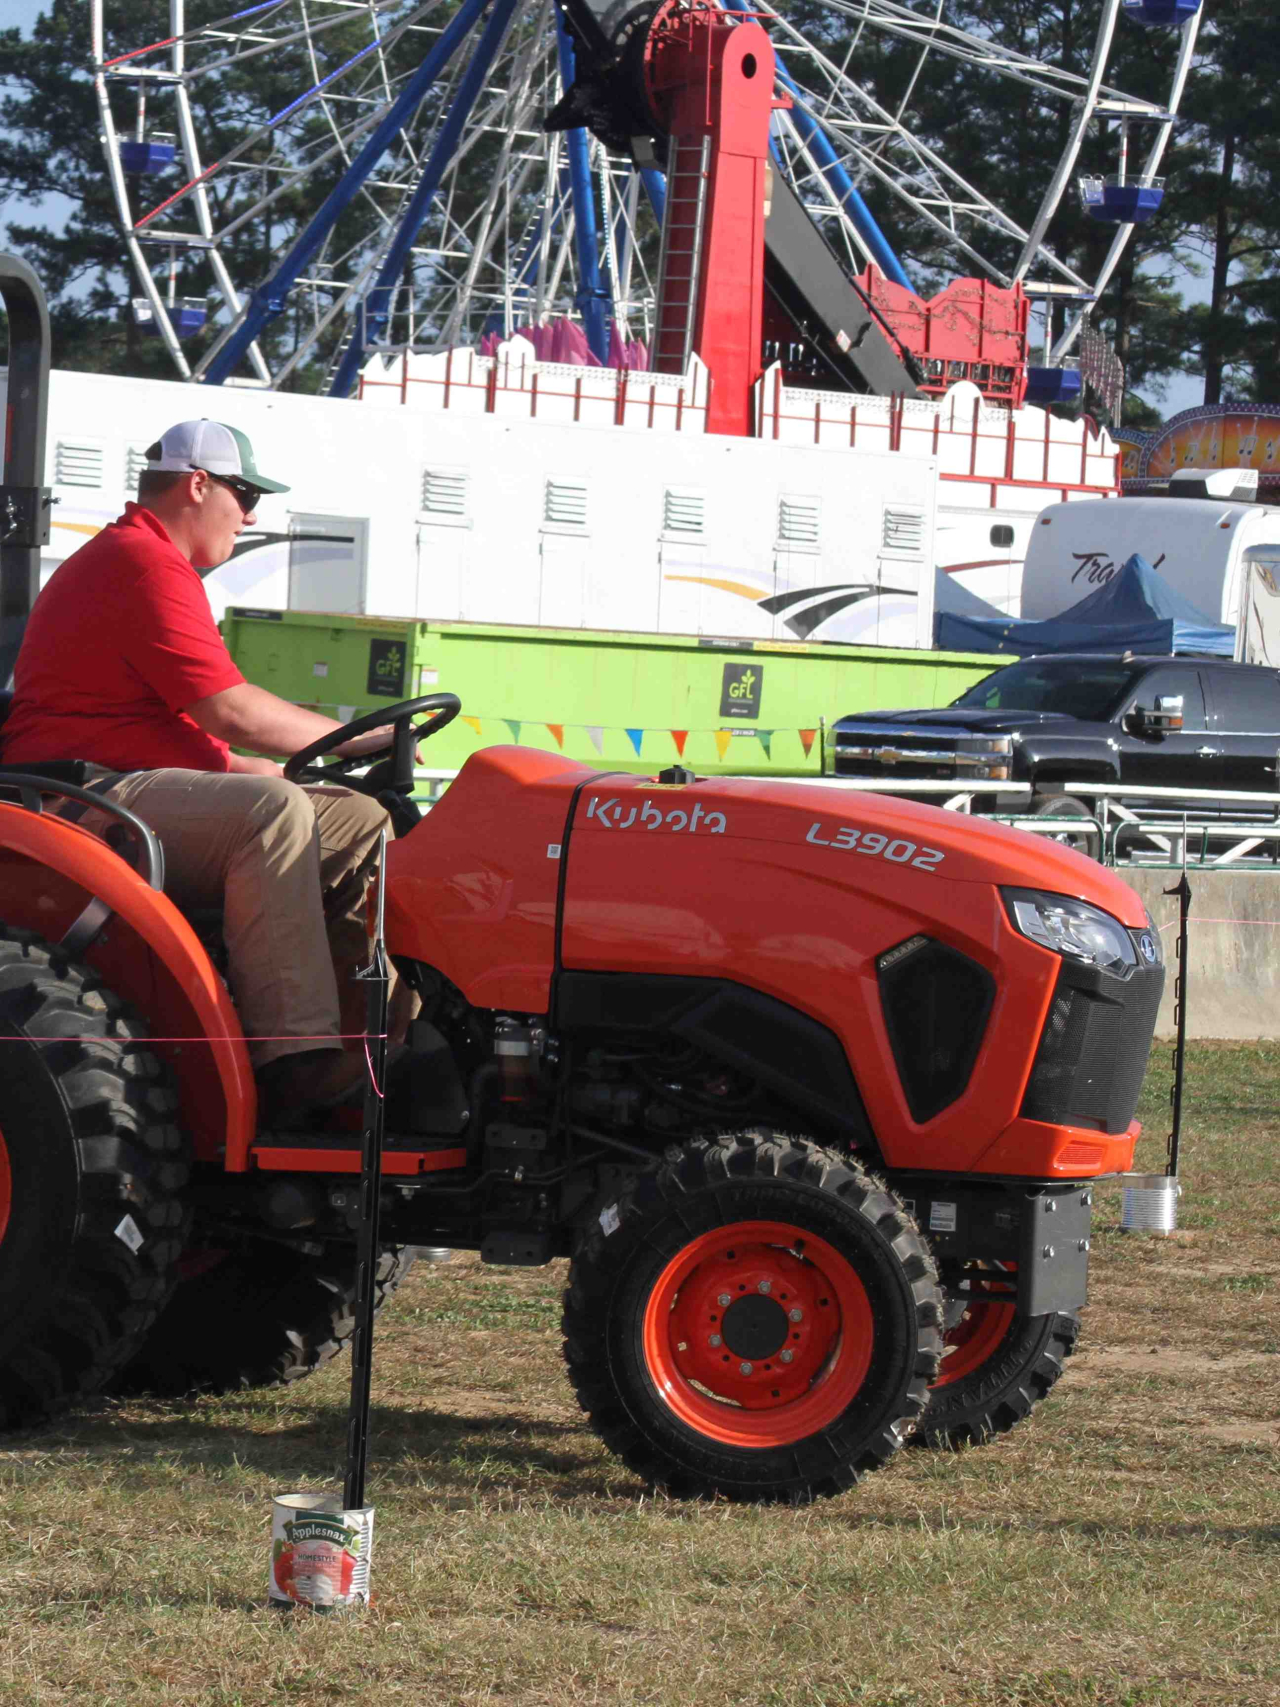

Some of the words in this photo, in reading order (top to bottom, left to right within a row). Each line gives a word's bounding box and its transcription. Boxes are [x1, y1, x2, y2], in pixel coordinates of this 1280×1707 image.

[729, 680, 753, 699] GFL
[586, 796, 727, 833] Kubota
[805, 823, 945, 872] L3902
[292, 1524, 347, 1543] Applesnax
[297, 1553, 337, 1563] HOMESTYLE
